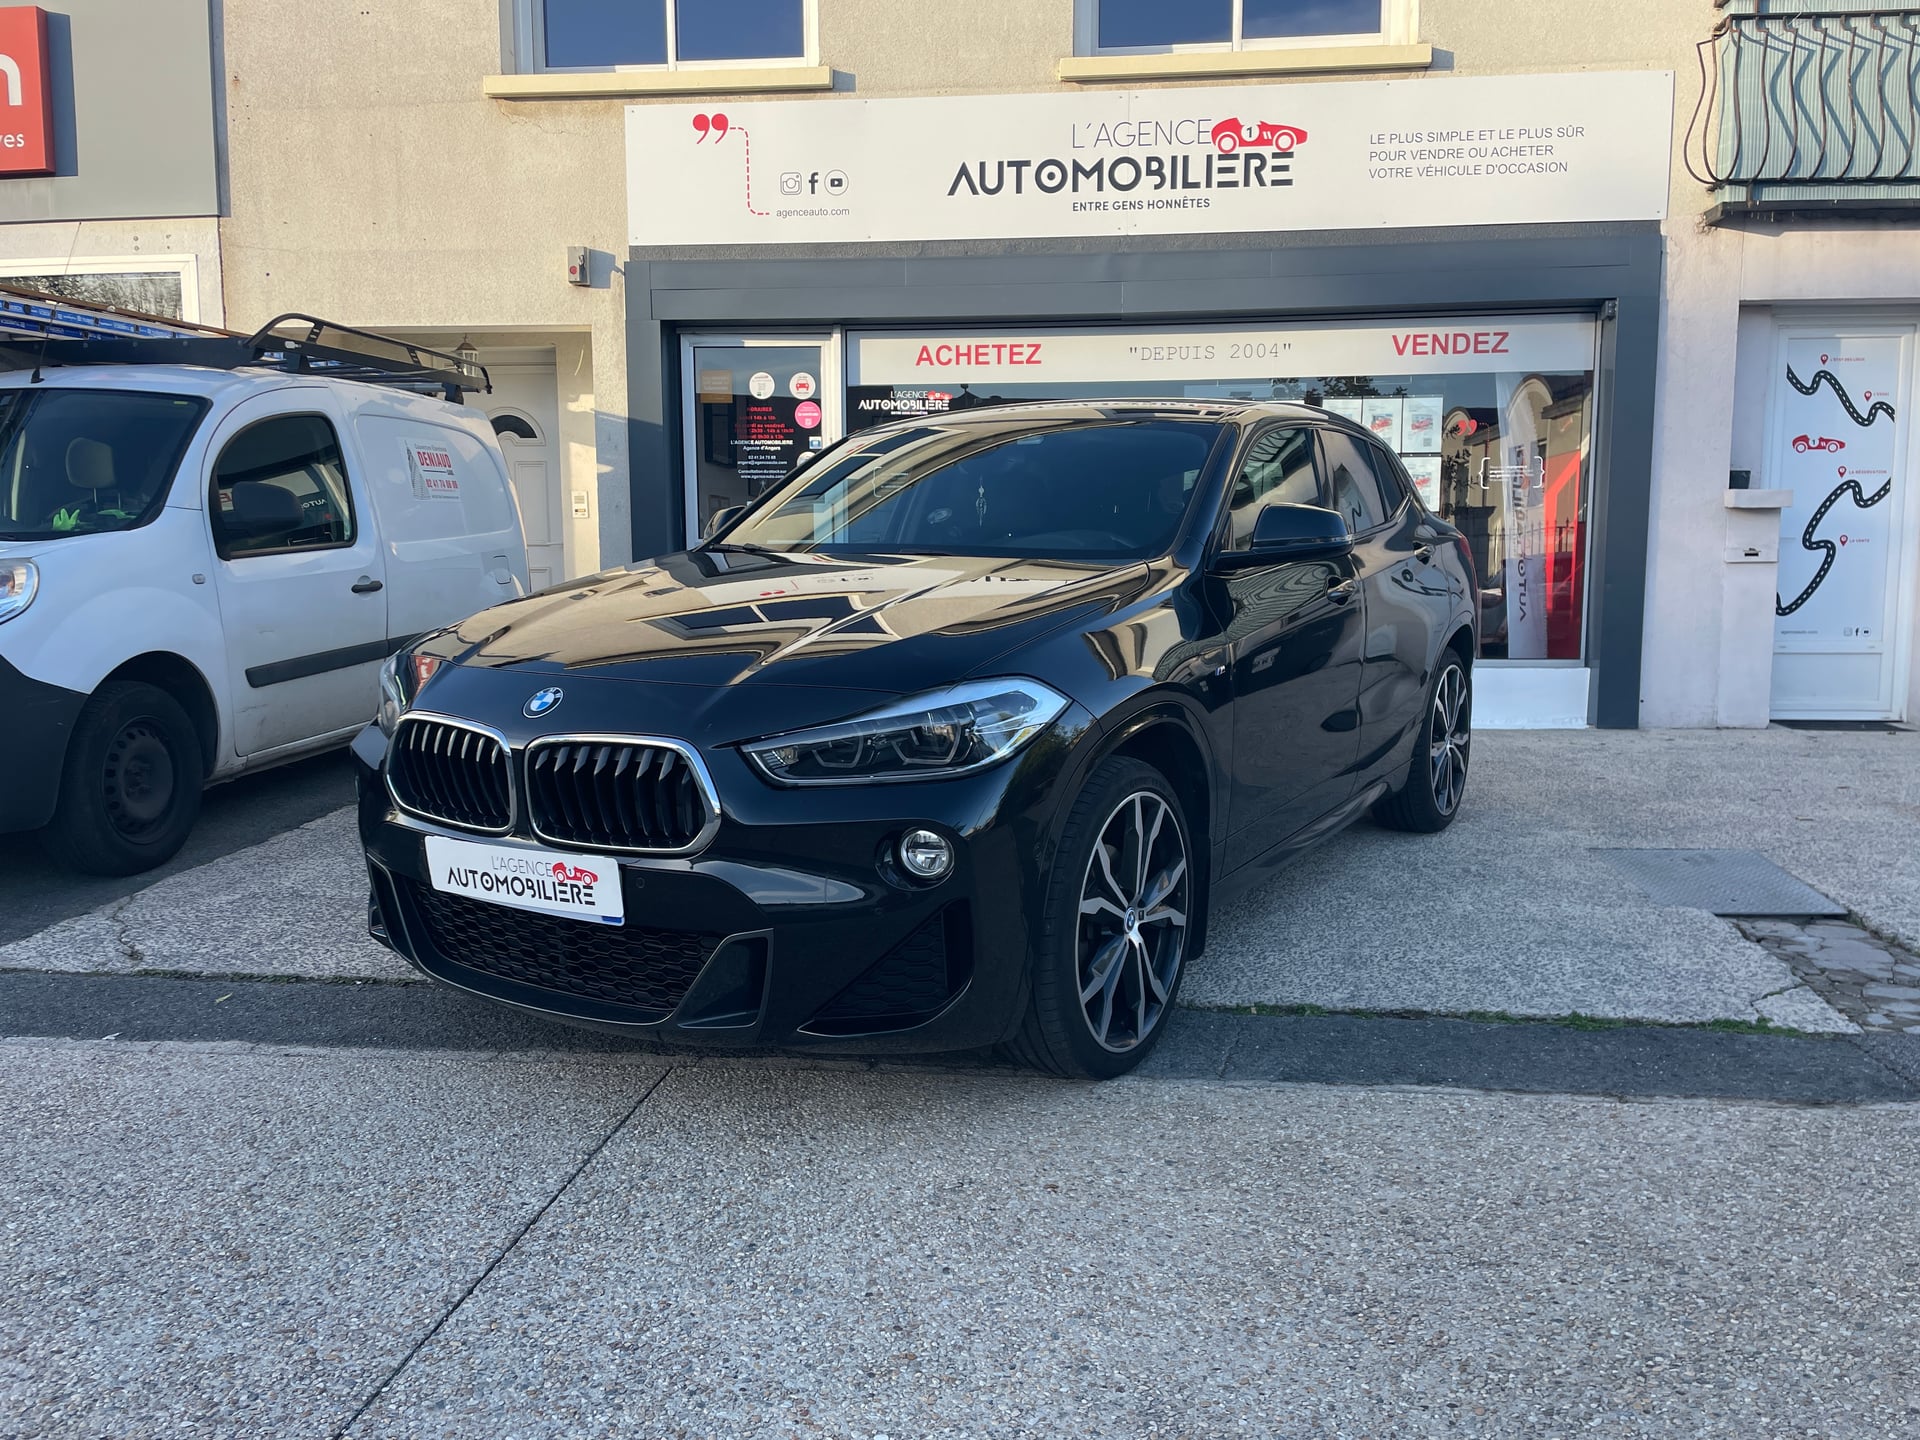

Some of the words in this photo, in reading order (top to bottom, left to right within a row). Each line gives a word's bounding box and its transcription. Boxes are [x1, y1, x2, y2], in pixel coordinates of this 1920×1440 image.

[1072, 118, 1213, 149] L'AGENCE
[1370, 134, 1386, 145] LE
[1390, 132, 1423, 144] PLUS
[1427, 130, 1475, 143] SIMPLE
[1478, 129, 1496, 141] ET
[1499, 129, 1515, 140] LE
[1519, 127, 1553, 139] PLUS
[1556, 125, 1585, 138] SÛR
[1369, 150, 1407, 162] POUR
[1410, 148, 1465, 160] VENDRE
[1468, 147, 1488, 158] OU
[1491, 145, 1554, 157] ACHETER
[1369, 167, 1413, 179] VOTRE
[1417, 164, 1482, 177] VÉHICULE
[1485, 161, 1568, 175] D'OCCASION
[776, 208, 850, 219] agenceauto.com
[1072, 201, 1110, 212] ENTRE
[1112, 200, 1144, 211] GENS
[1147, 196, 1211, 210] HONNÊTES
[1391, 332, 1510, 356] VENDEZ
[915, 343, 1042, 366] ACHETEZ
[890, 390, 929, 399] L'AGENCE
[491, 855, 553, 878] L'AGENCE
